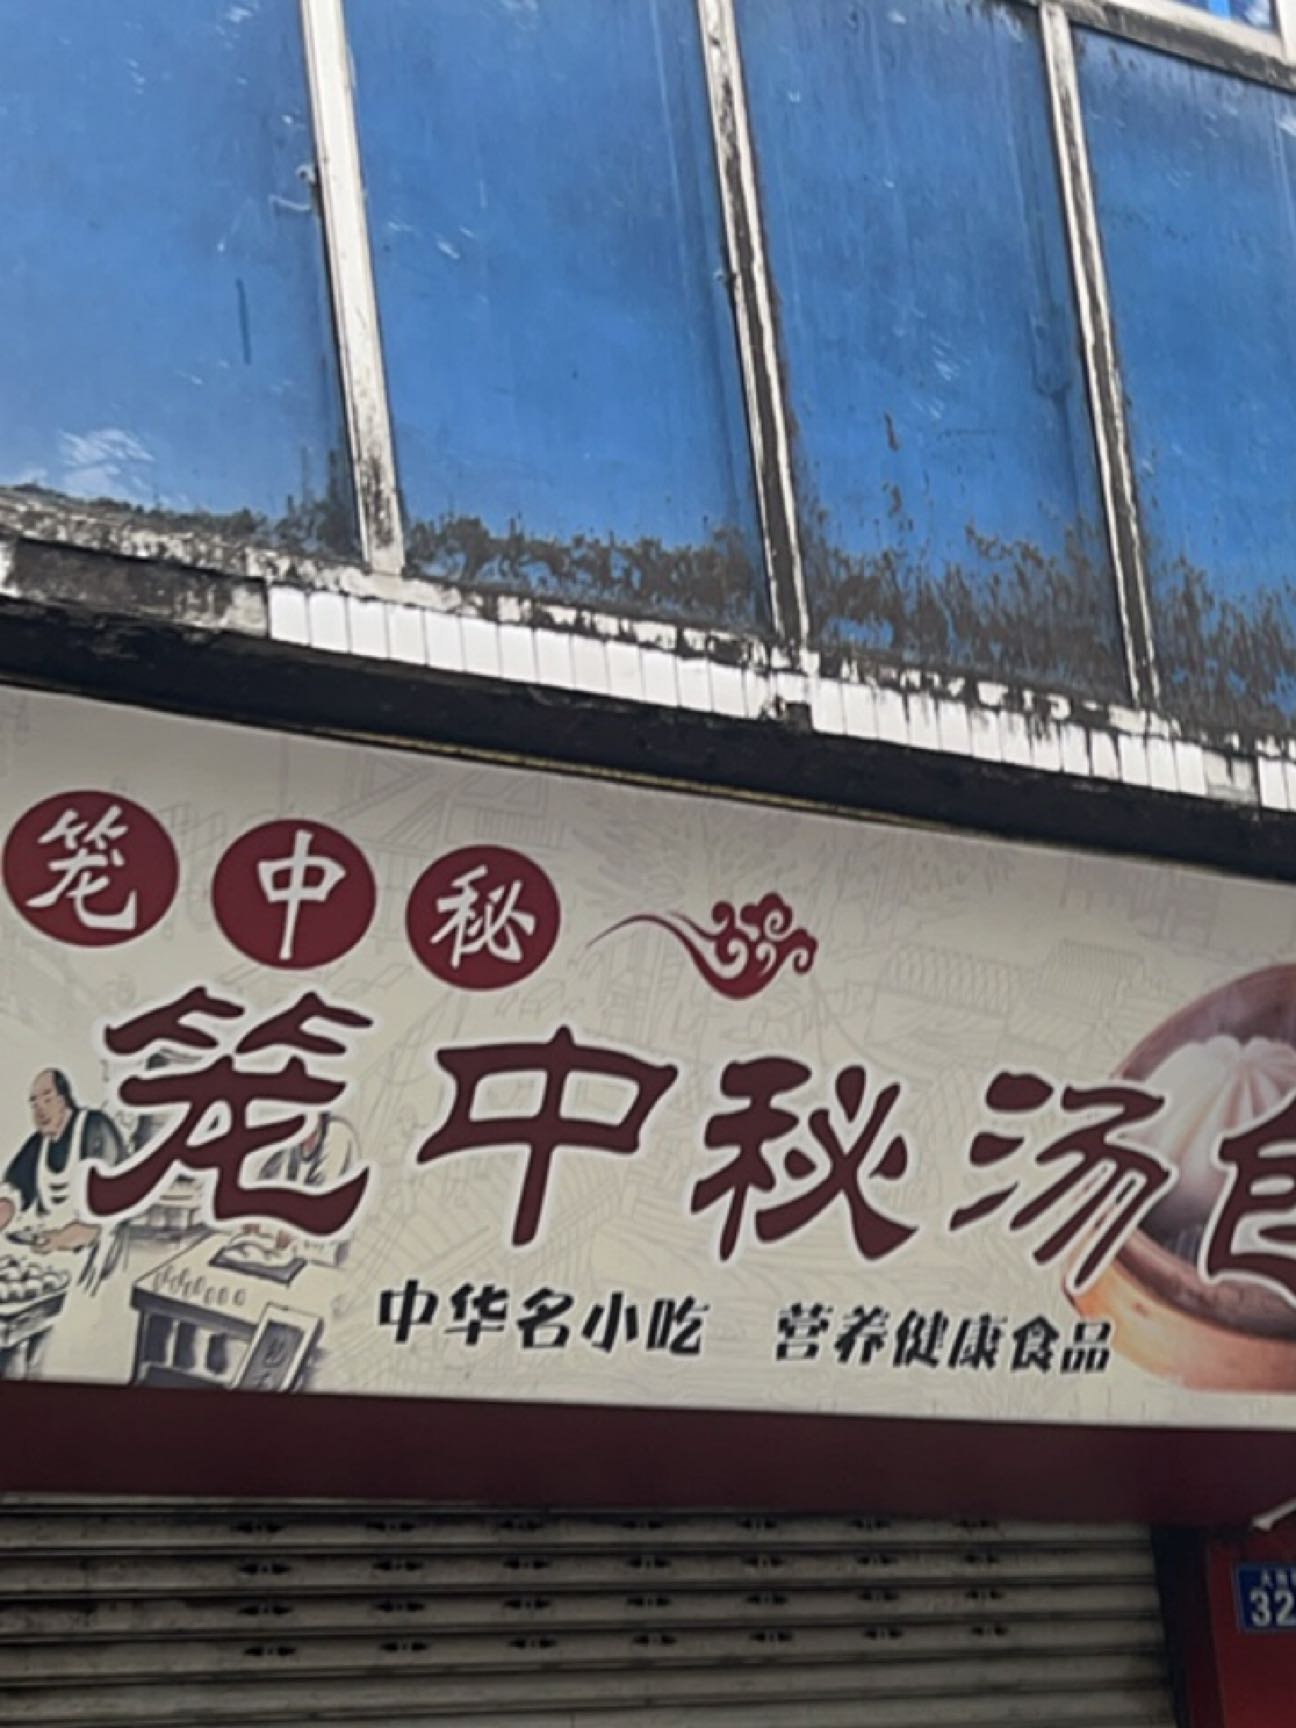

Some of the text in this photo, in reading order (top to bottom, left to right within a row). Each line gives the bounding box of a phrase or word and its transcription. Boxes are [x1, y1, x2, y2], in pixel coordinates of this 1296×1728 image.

[377, 1279, 1113, 1374] 中华名小吃 营养健康食品
